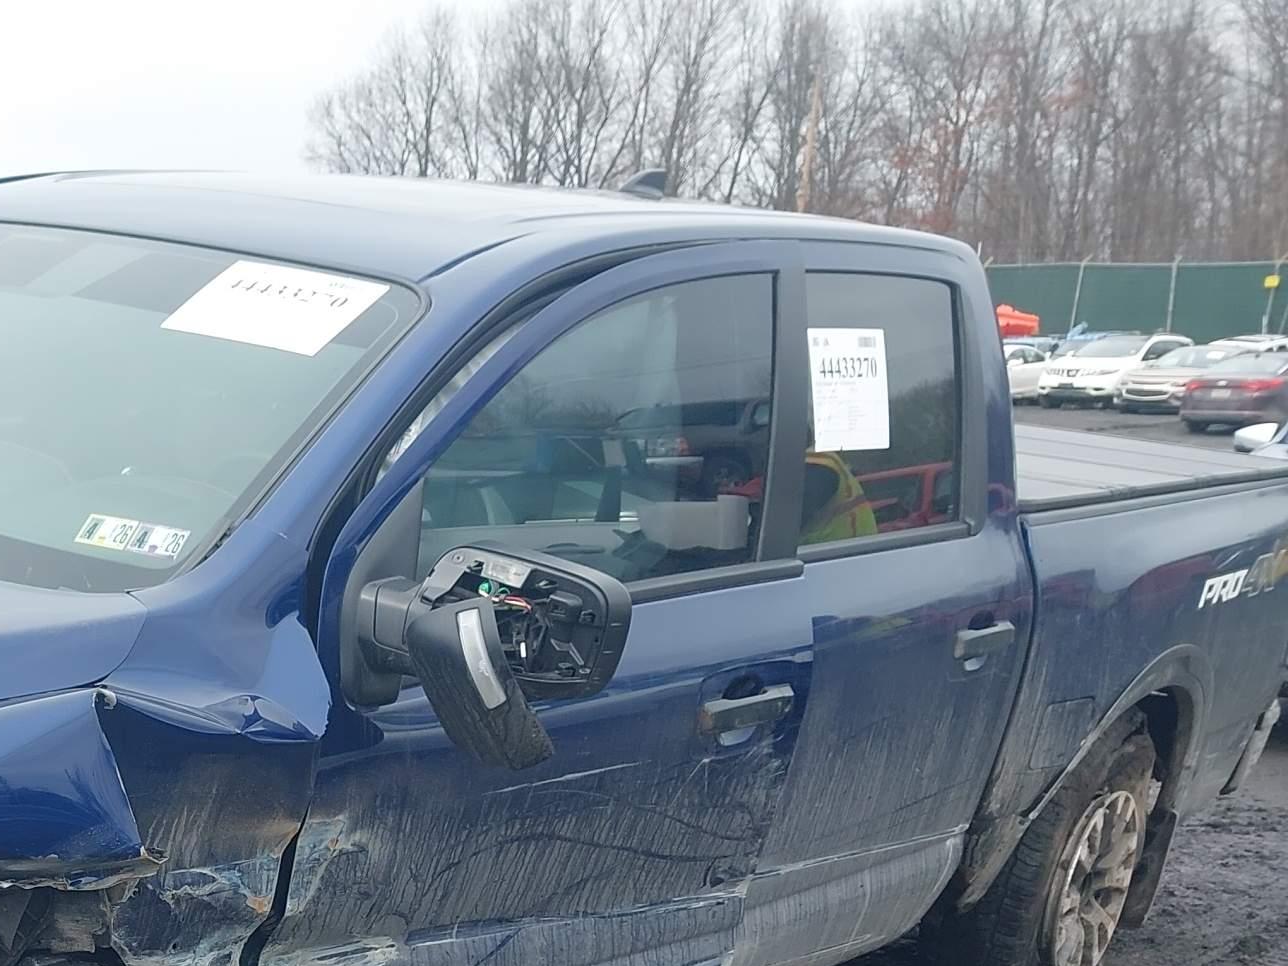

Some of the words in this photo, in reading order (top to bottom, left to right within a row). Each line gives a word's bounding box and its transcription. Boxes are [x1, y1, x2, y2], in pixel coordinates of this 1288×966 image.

[819, 357, 878, 379] 44433270
[113, 523, 134, 544] 26
[165, 533, 185, 554] 26
